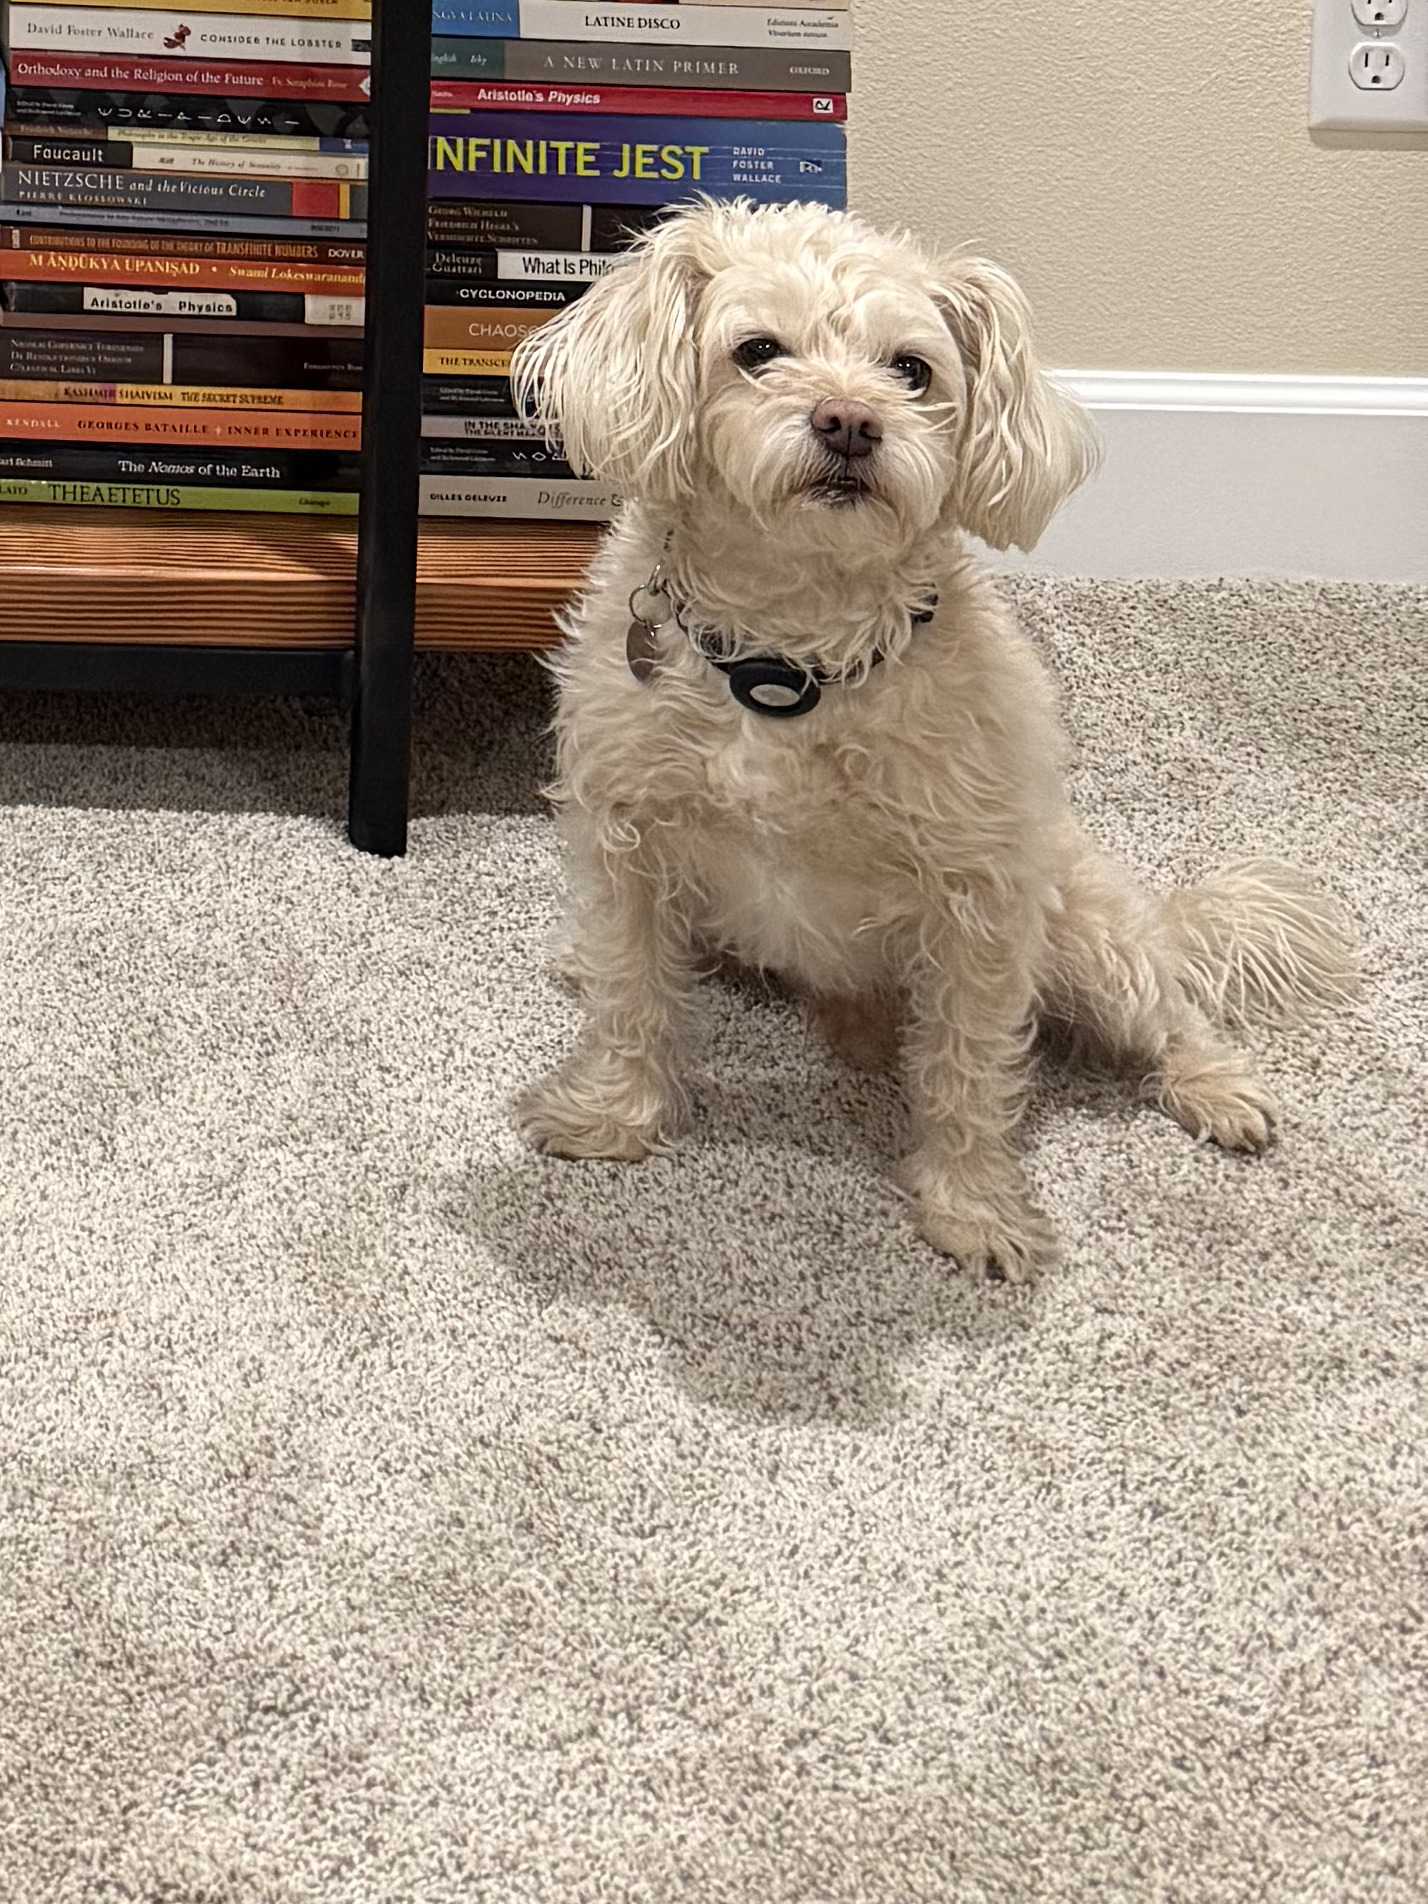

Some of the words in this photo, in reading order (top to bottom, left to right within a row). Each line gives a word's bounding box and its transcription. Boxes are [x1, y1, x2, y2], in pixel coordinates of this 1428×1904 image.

[584, 15, 635, 30] LATINE
[638, 15, 680, 30] DISCO
[430, 136, 601, 177] NFINITE
[613, 144, 709, 181] JEST
[460, 289, 566, 301] CYCLONOPEDIA
[48, 482, 181, 505] THEAETETUS
